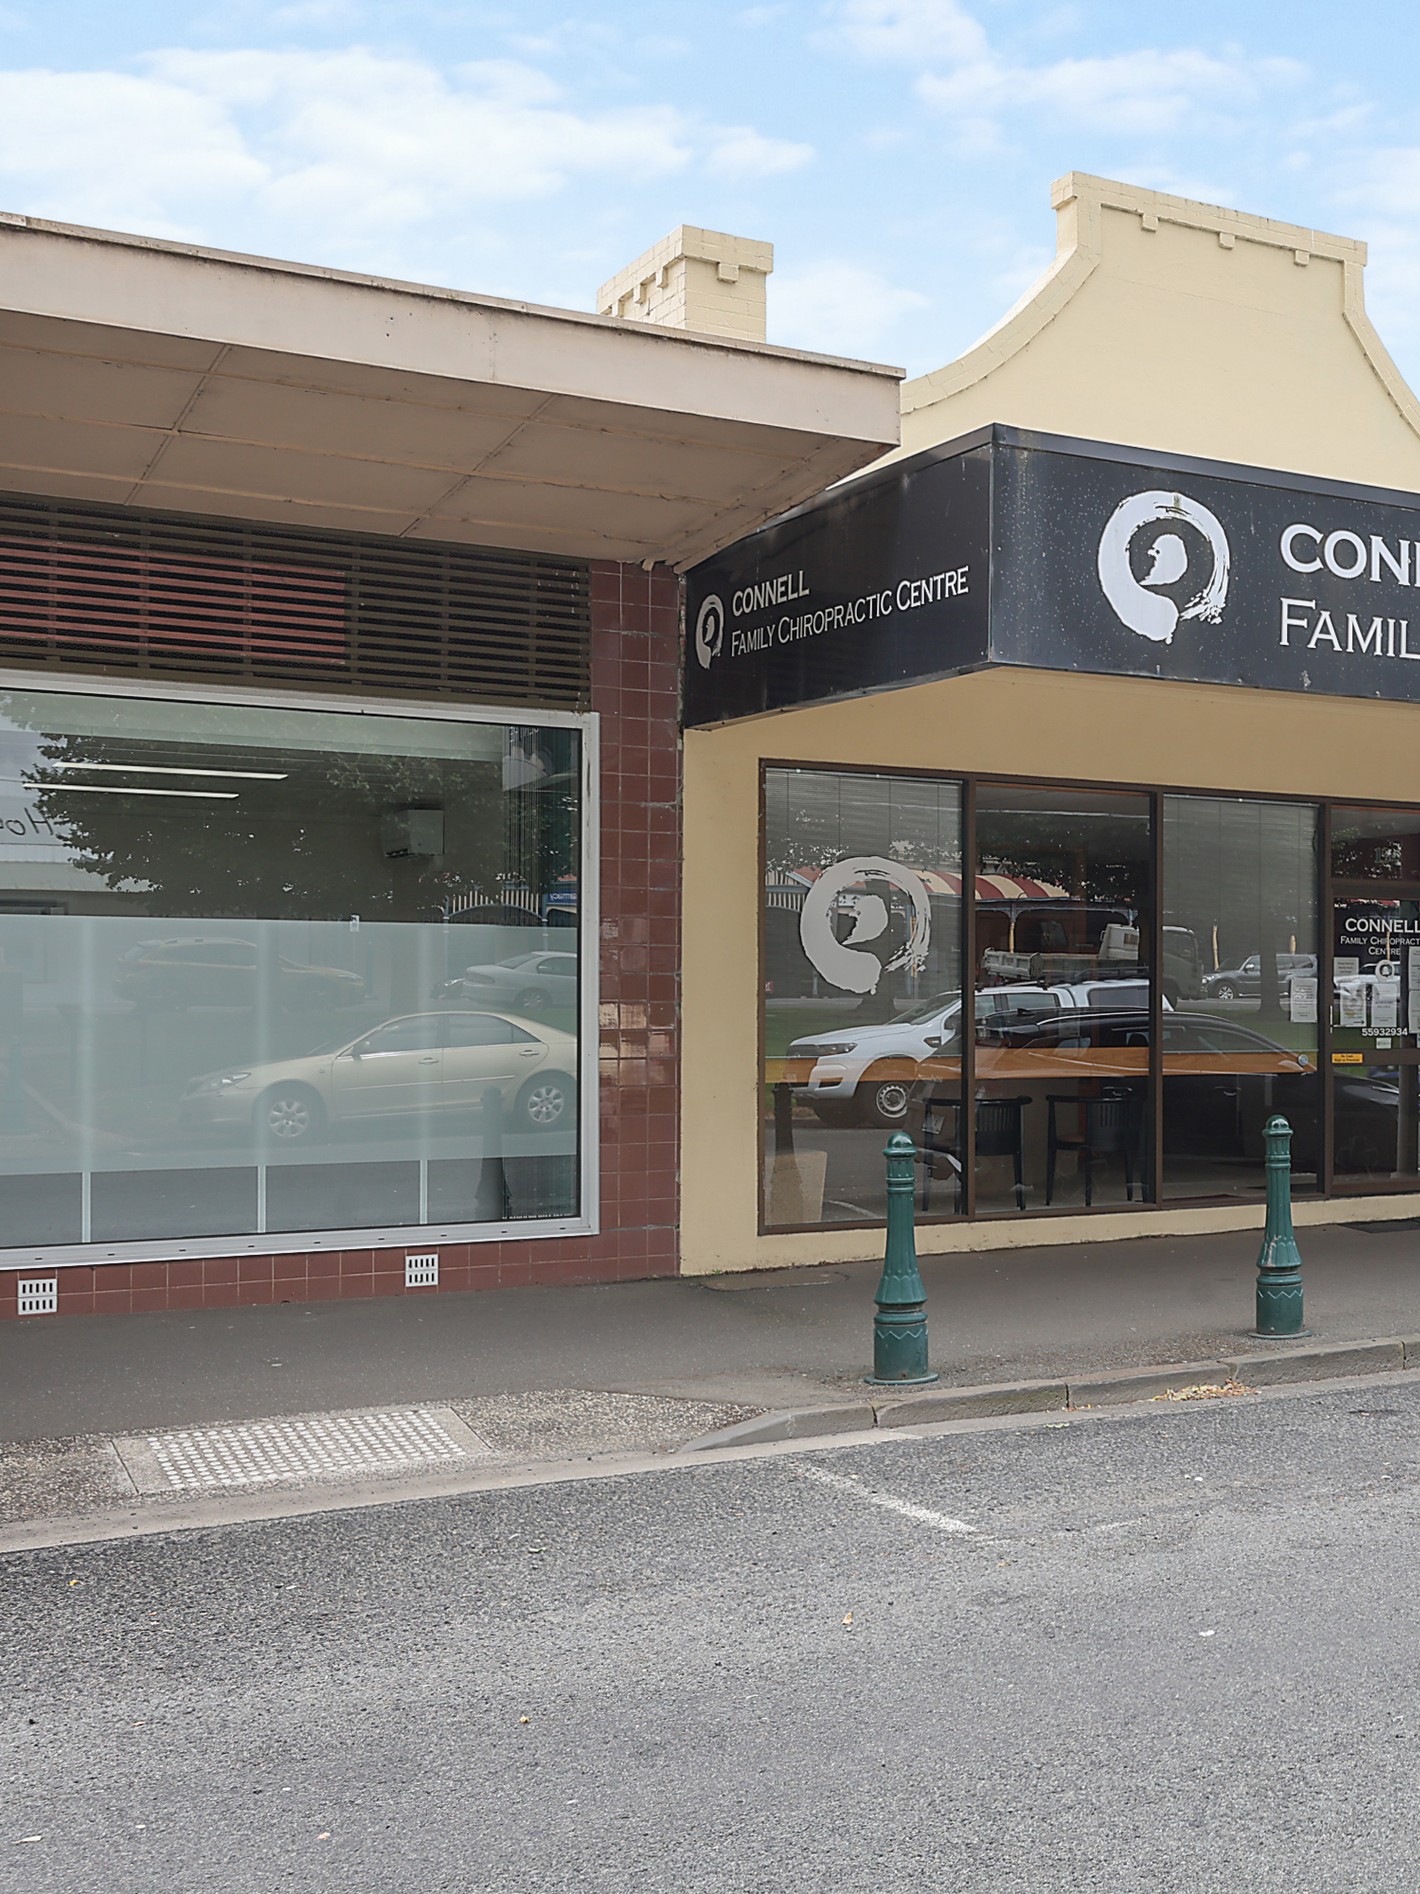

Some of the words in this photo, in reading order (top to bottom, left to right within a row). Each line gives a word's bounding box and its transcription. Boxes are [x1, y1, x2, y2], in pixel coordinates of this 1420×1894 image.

[732, 570, 810, 617] CONNELL
[731, 624, 776, 657] FAMILY
[778, 589, 893, 644] CHIROPRACTIC
[896, 565, 969, 611] CENTRE
[1340, 935, 1368, 945] FAMILY
[1361, 1027, 1409, 1037] 55932934
